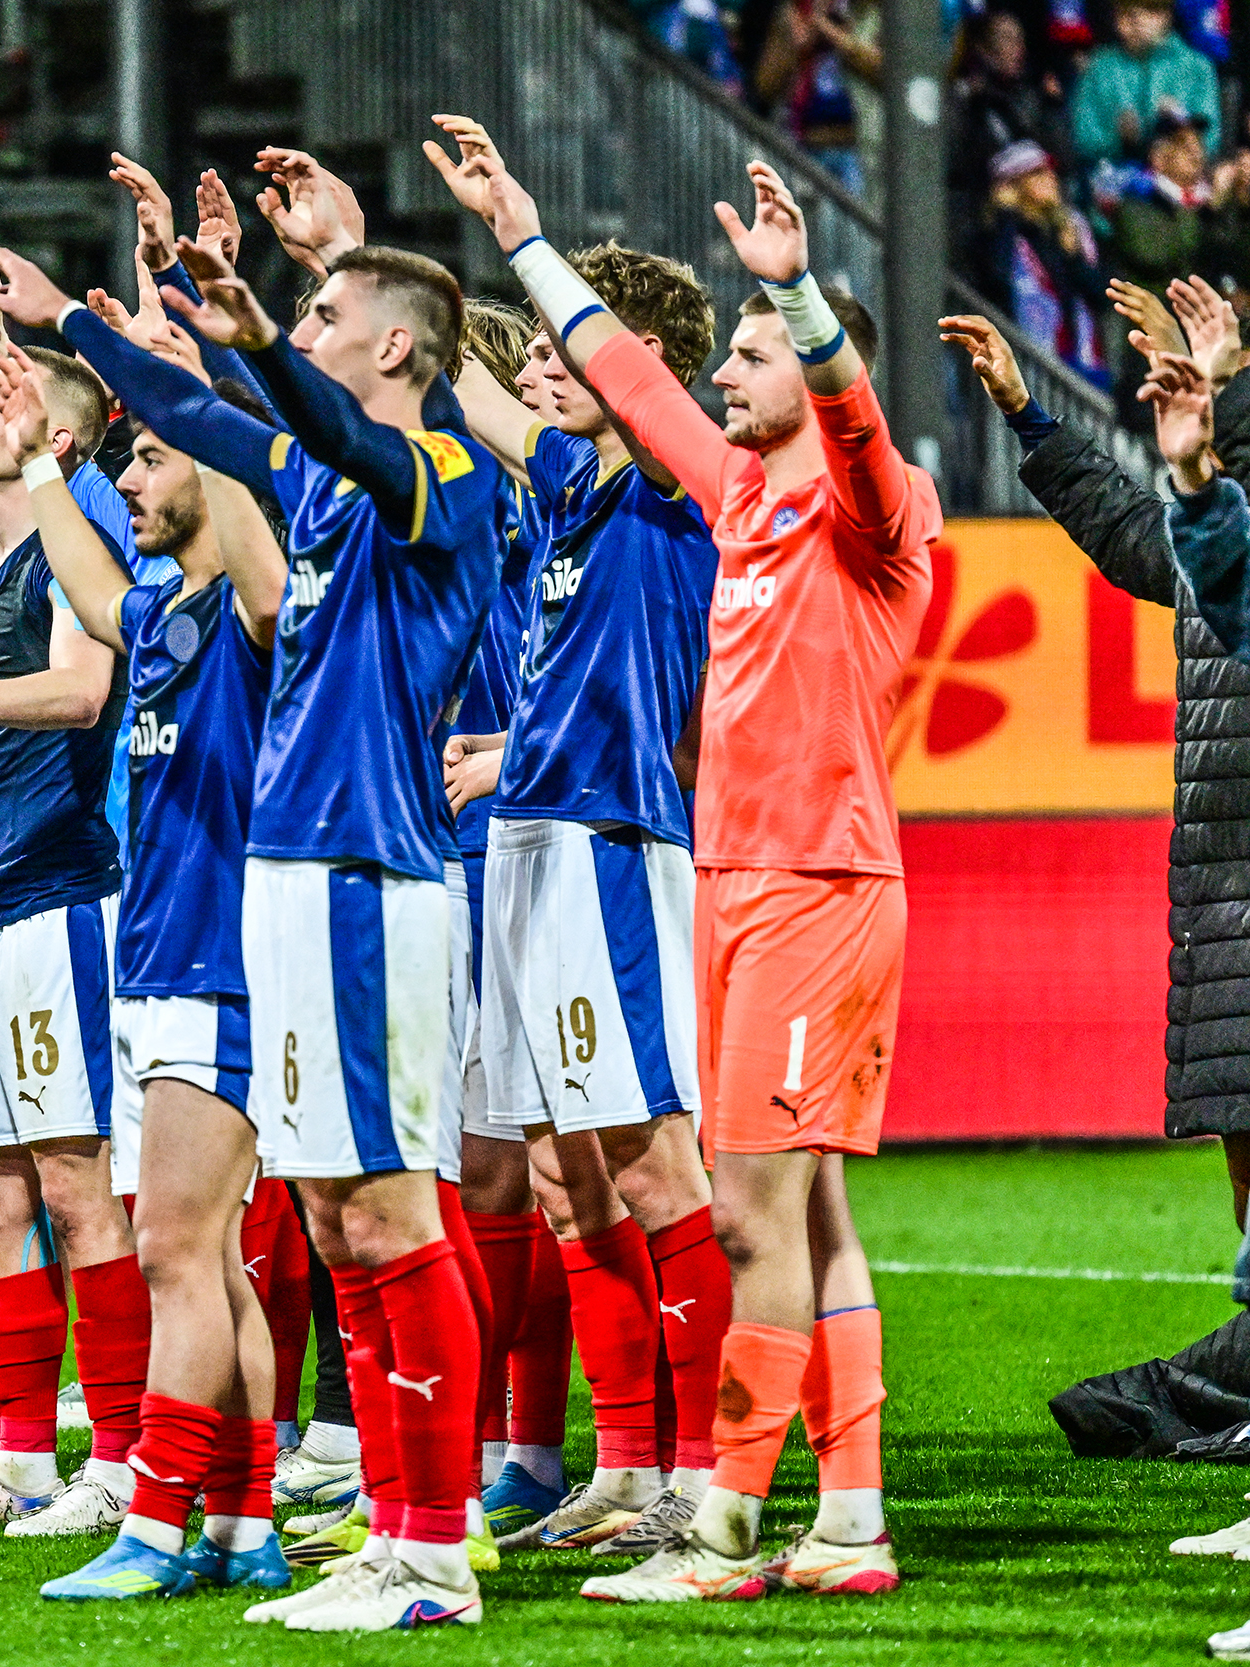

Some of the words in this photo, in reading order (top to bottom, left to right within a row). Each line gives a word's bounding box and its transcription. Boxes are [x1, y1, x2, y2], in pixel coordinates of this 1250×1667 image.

[10, 1009, 60, 1081] 13
[284, 1030, 299, 1106] 6
[557, 996, 597, 1069] 19
[783, 1015, 808, 1091] 1
